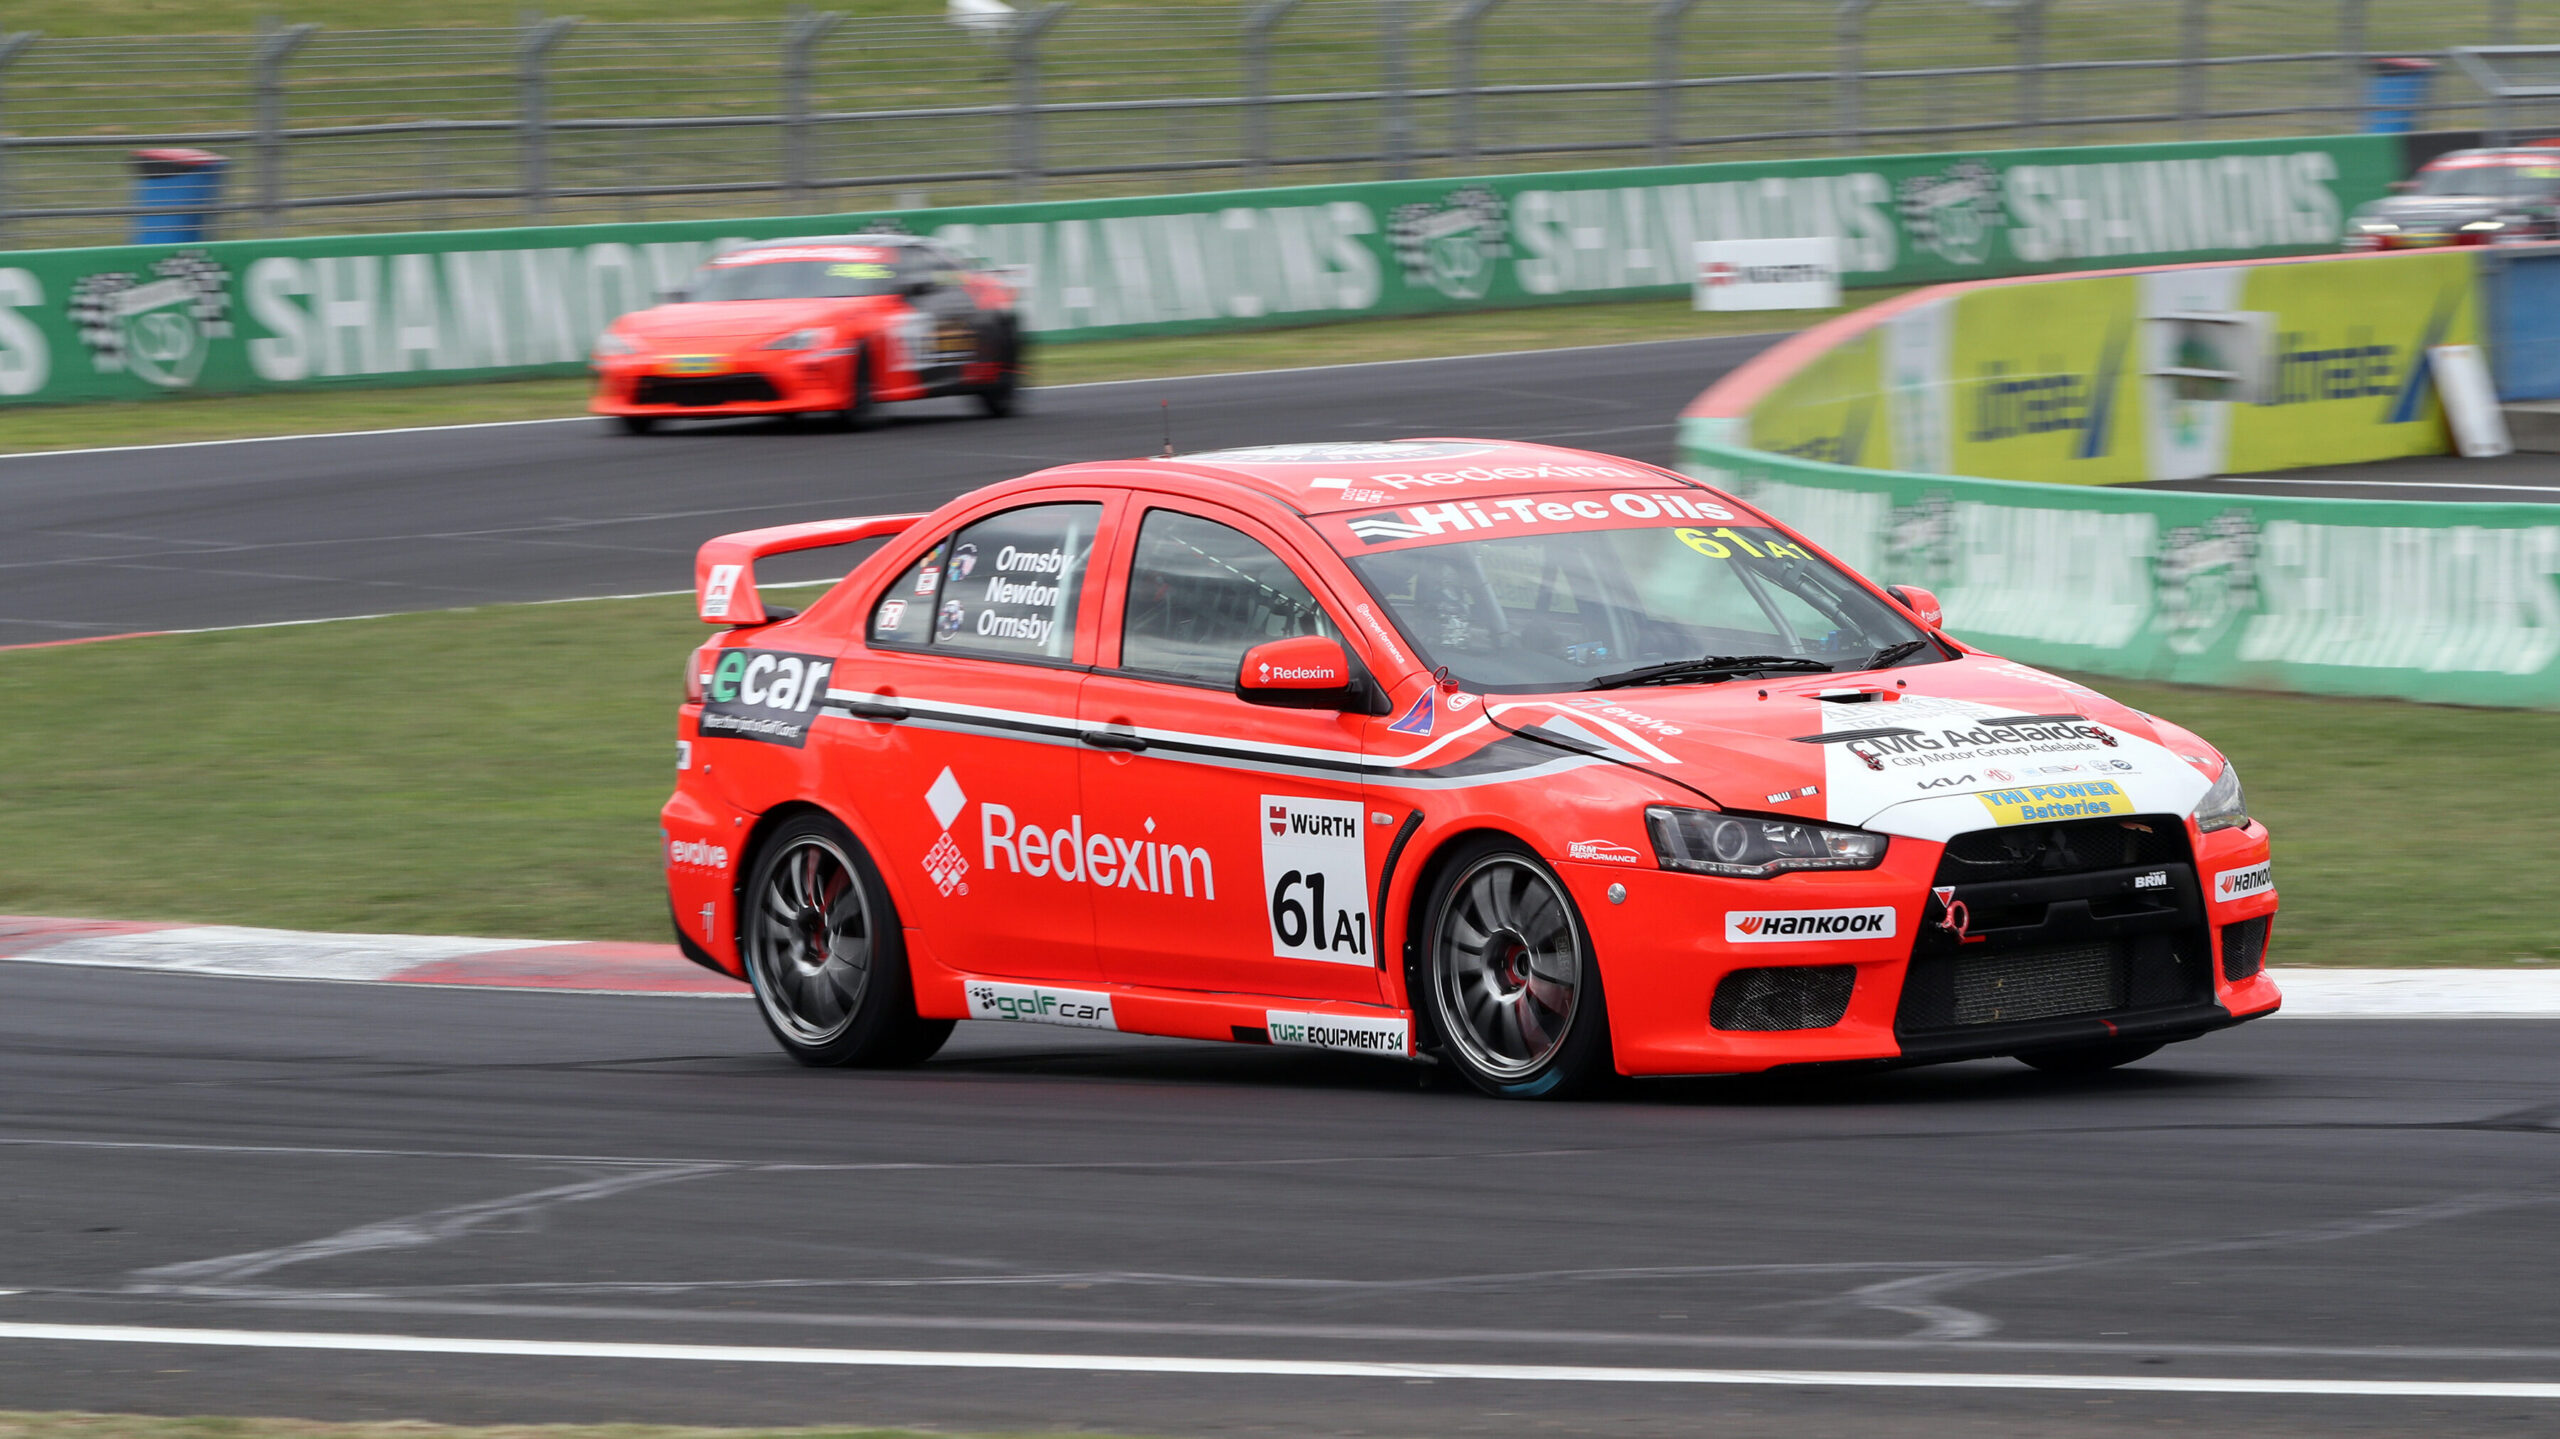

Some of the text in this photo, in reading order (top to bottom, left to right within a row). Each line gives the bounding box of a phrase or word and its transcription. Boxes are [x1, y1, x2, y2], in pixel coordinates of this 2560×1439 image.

[243, 235, 752, 382] SHANNO
[1371, 463, 1636, 491] Redexim
[1407, 492, 1736, 535] Hi-Tec Oils
[1674, 527, 1815, 561] 61 A1
[996, 545, 1074, 581] Ormsby
[985, 576, 1058, 607] Newton
[977, 609, 1053, 646] Ormsby
[712, 651, 833, 712] ecar
[1273, 665, 1336, 679] Redexim
[1601, 706, 1684, 736] evolve
[1942, 722, 2097, 748] Adelaide
[1892, 742, 2099, 767] City Motor Group Adelaide
[1981, 781, 2120, 807] YHI POWER
[2020, 800, 2112, 821] Batteries
[1290, 812, 1356, 839] WÜRTH
[981, 801, 1216, 901] Redexim
[1568, 851, 1637, 864] PERFORMANCE
[1570, 844, 1597, 854] BRM
[2135, 876, 2168, 889] BRM
[1272, 868, 1368, 956] 61 A1
[997, 989, 1110, 1021] golf car
[1270, 1023, 1305, 1042] TURF
[1307, 1026, 1387, 1049] EQUIPMENT
